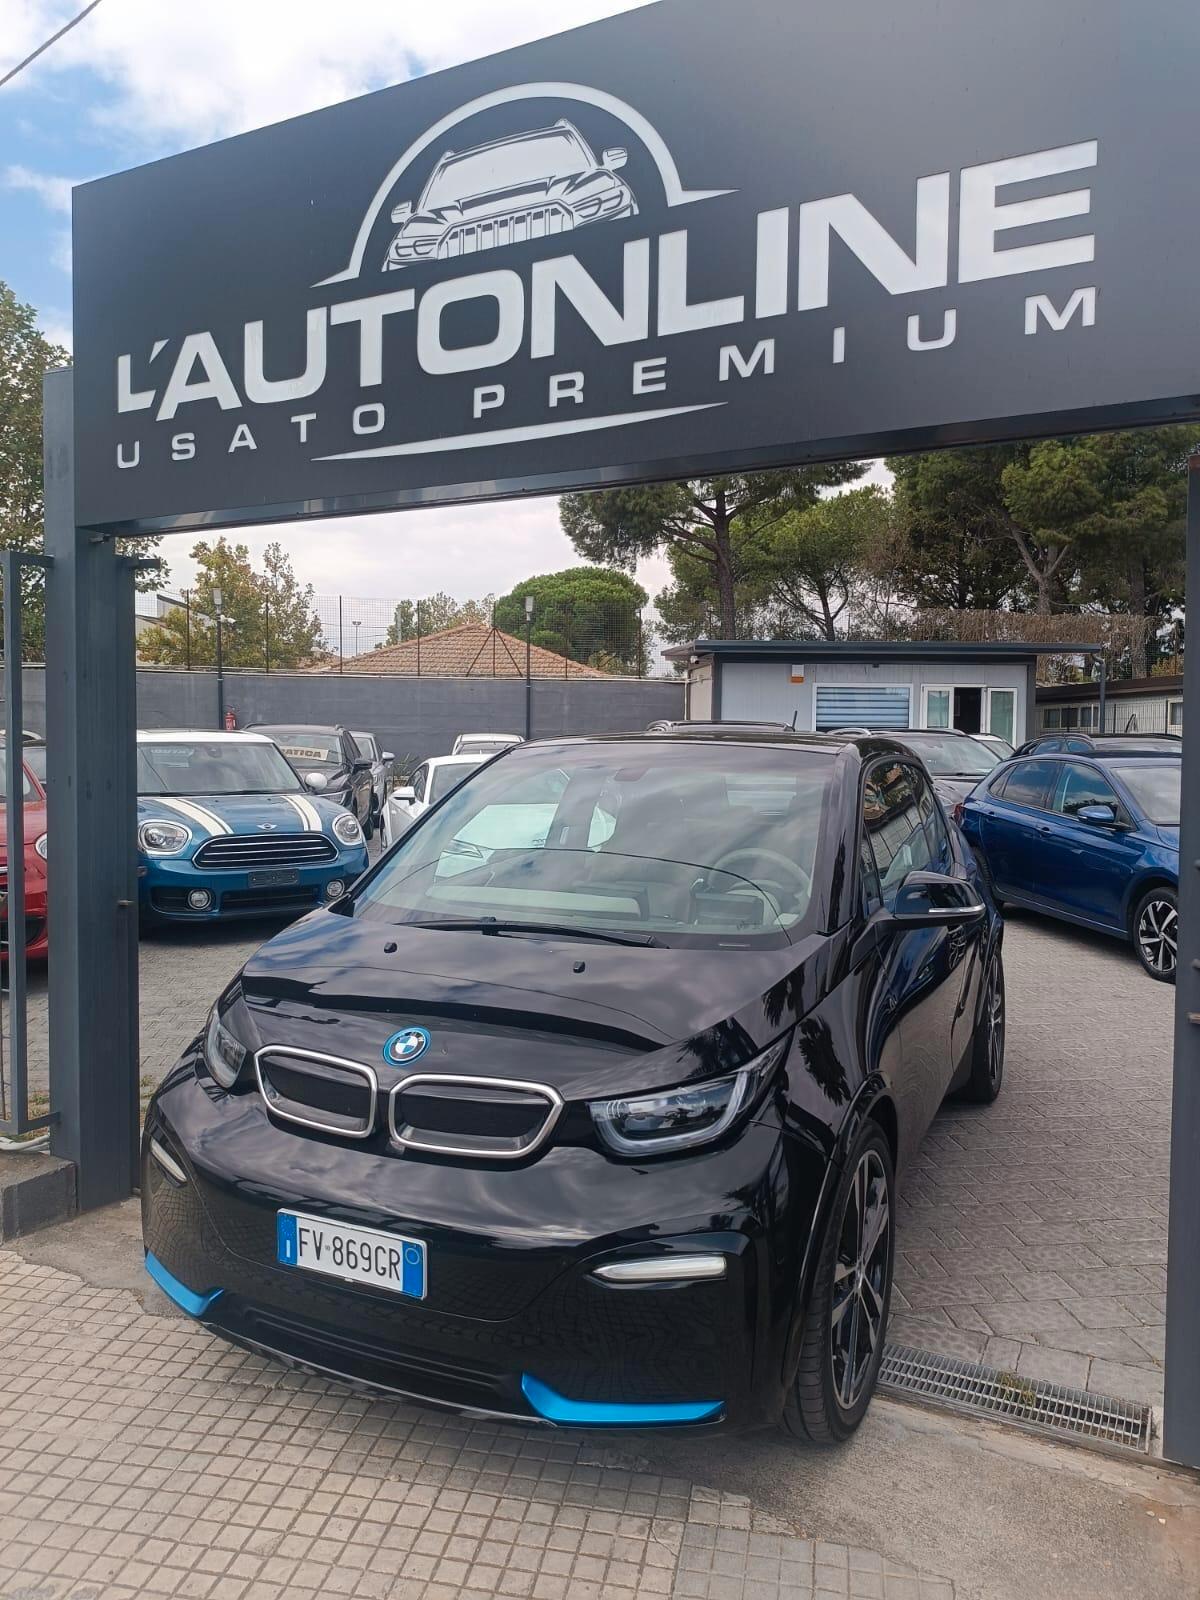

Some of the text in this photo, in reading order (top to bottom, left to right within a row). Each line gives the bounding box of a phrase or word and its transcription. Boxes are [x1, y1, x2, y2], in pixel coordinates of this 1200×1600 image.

[117, 138, 1098, 421] L'AUTONLINE
[117, 286, 1096, 468] USATO PREMIUM
[282, 749, 321, 758] ATICA
